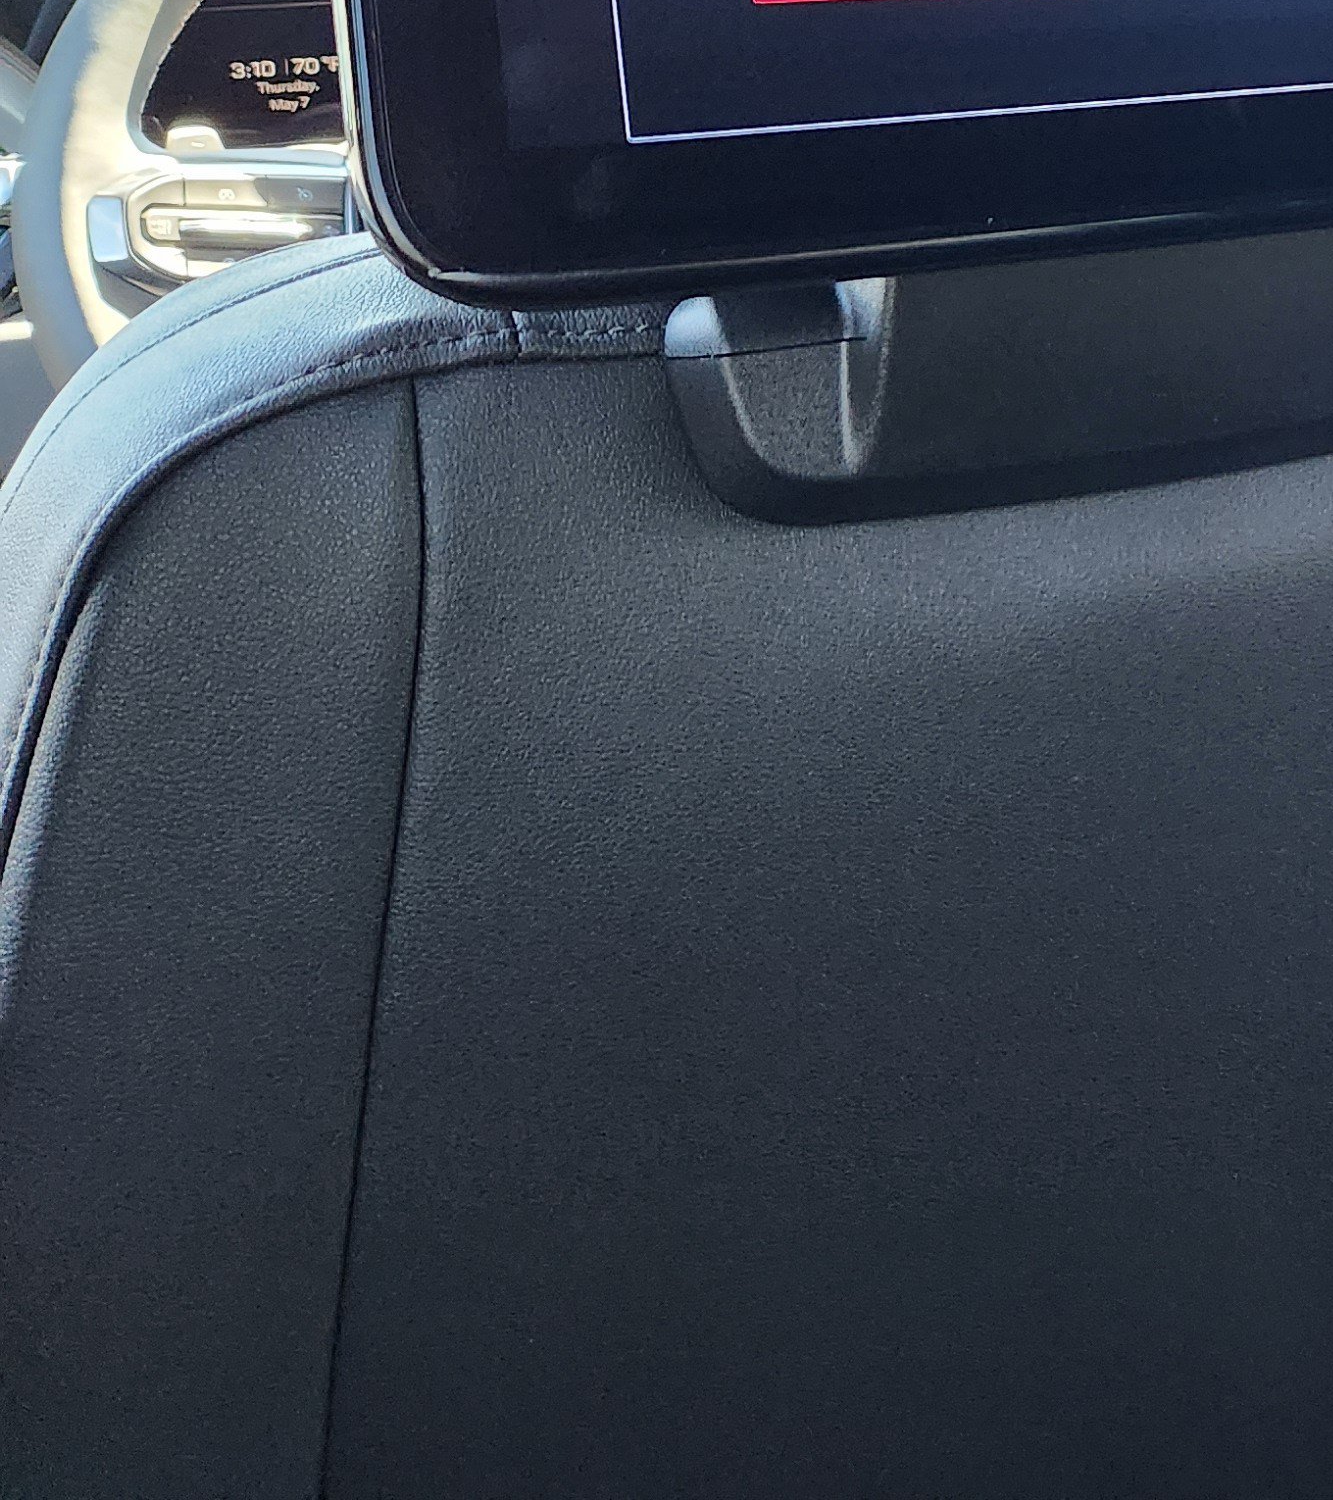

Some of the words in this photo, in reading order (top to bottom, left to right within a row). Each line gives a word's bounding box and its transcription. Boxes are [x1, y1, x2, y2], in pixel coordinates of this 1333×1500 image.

[229, 59, 277, 80] 3:10
[255, 79, 321, 95] Thursday,
[268, 98, 299, 113] May
[298, 95, 311, 109] 7
